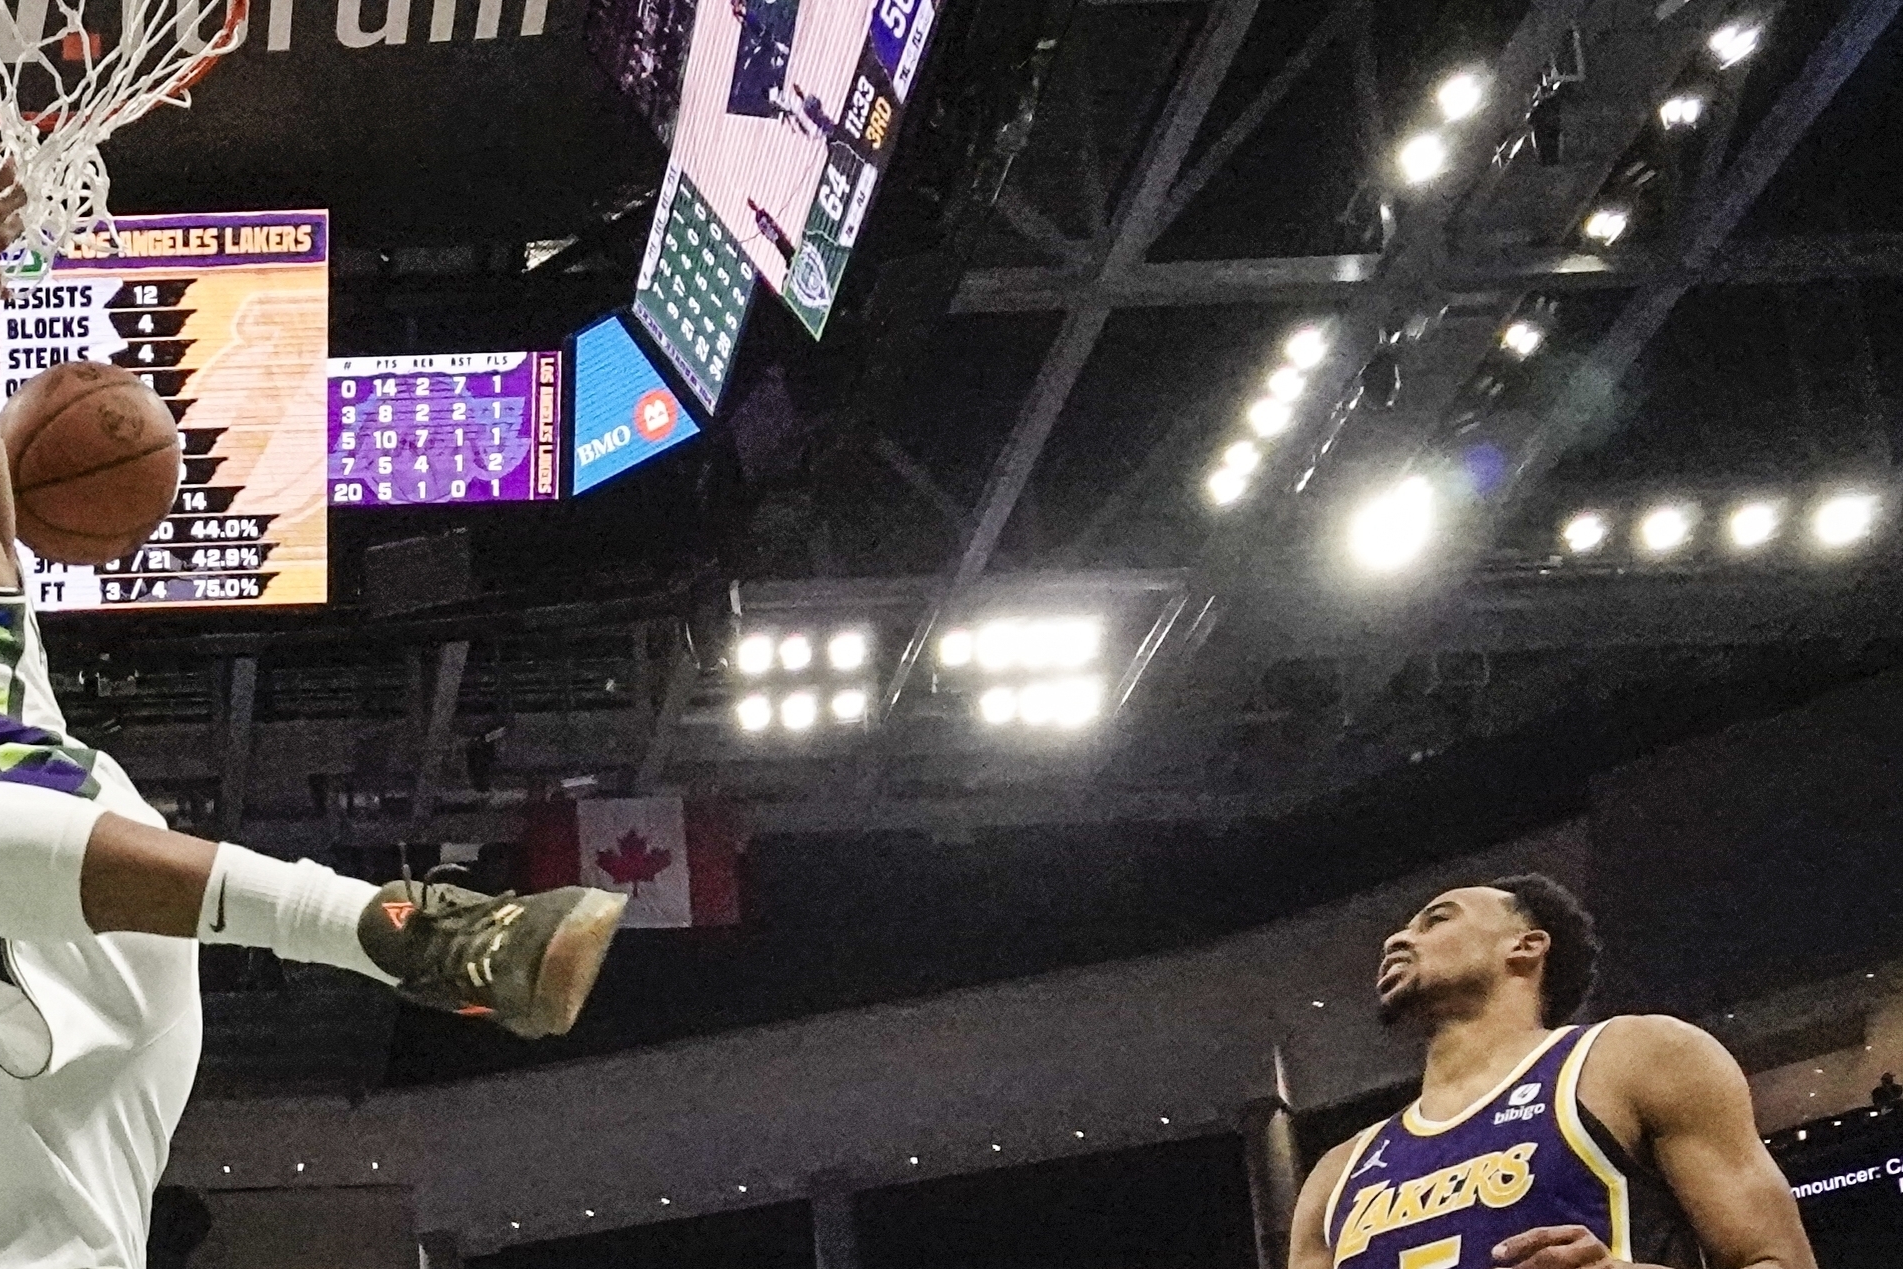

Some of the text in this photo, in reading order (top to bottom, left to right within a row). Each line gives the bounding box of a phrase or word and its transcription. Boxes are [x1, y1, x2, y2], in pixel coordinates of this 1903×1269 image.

[845, 75, 875, 139] 11:33
[865, 96, 892, 150] 3RD
[819, 163, 850, 221] 64
[119, 227, 218, 257] ANGELES
[225, 225, 312, 254] LAKERS
[4, 286, 158, 309] ASSISTS 12
[7, 314, 154, 339] BLOCKS 4
[9, 344, 154, 369] STEALS 4
[377, 359, 397, 368] PTS
[487, 356, 508, 365] FLS
[341, 375, 501, 398] 0 14 2 7 1
[342, 402, 500, 423] 3 8 2 2 1
[342, 427, 500, 450] 5 10 7 1 1
[576, 425, 631, 467] BMO
[342, 453, 502, 475] 7 5 4 1 2
[183, 492, 207, 511] 14
[334, 480, 500, 501] 20 5 1 0 1
[191, 519, 258, 538] 44.0%
[149, 551, 171, 569] 21
[192, 548, 259, 567] 42.9%
[41, 578, 259, 602] FT 3 4 75.0%
[1493, 1103, 1546, 1125] bibigo
[1790, 1167, 1881, 1199] nnouncer:
